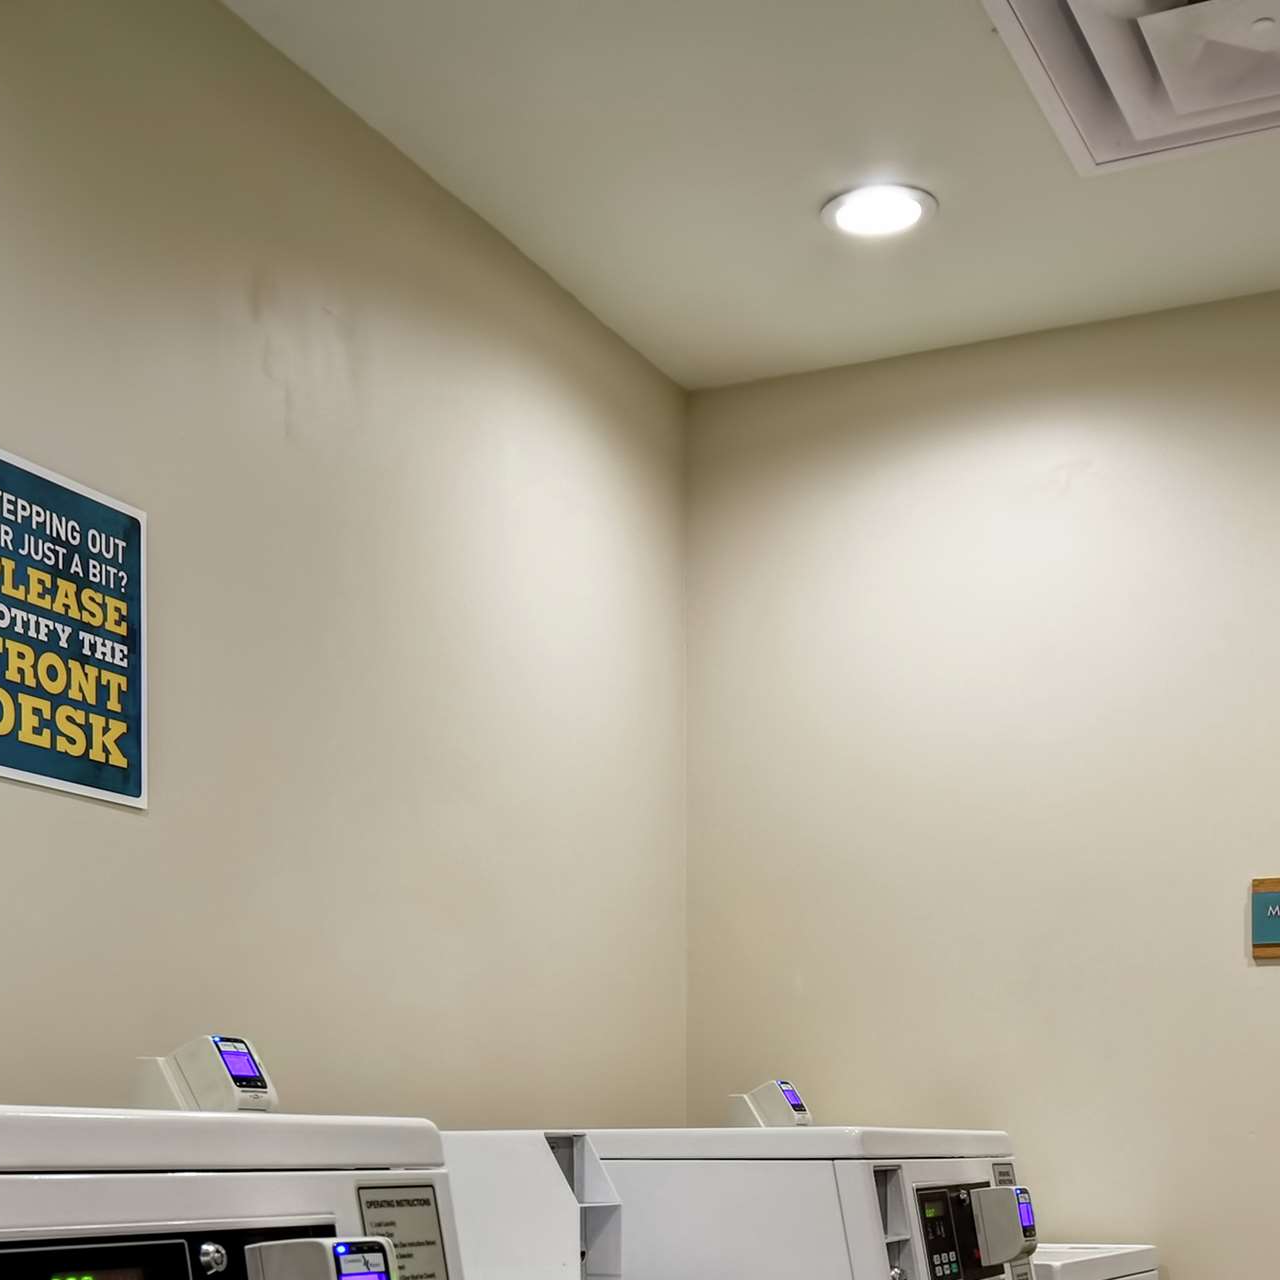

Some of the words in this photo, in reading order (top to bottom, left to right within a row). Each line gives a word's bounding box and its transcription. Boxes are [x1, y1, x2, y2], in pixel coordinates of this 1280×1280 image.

[18, 532, 66, 571] JUST
[70, 550, 84, 577] A
[89, 557, 129, 594] BIT?
[87, 529, 128, 565] OUT
[79, 630, 129, 668] THE
